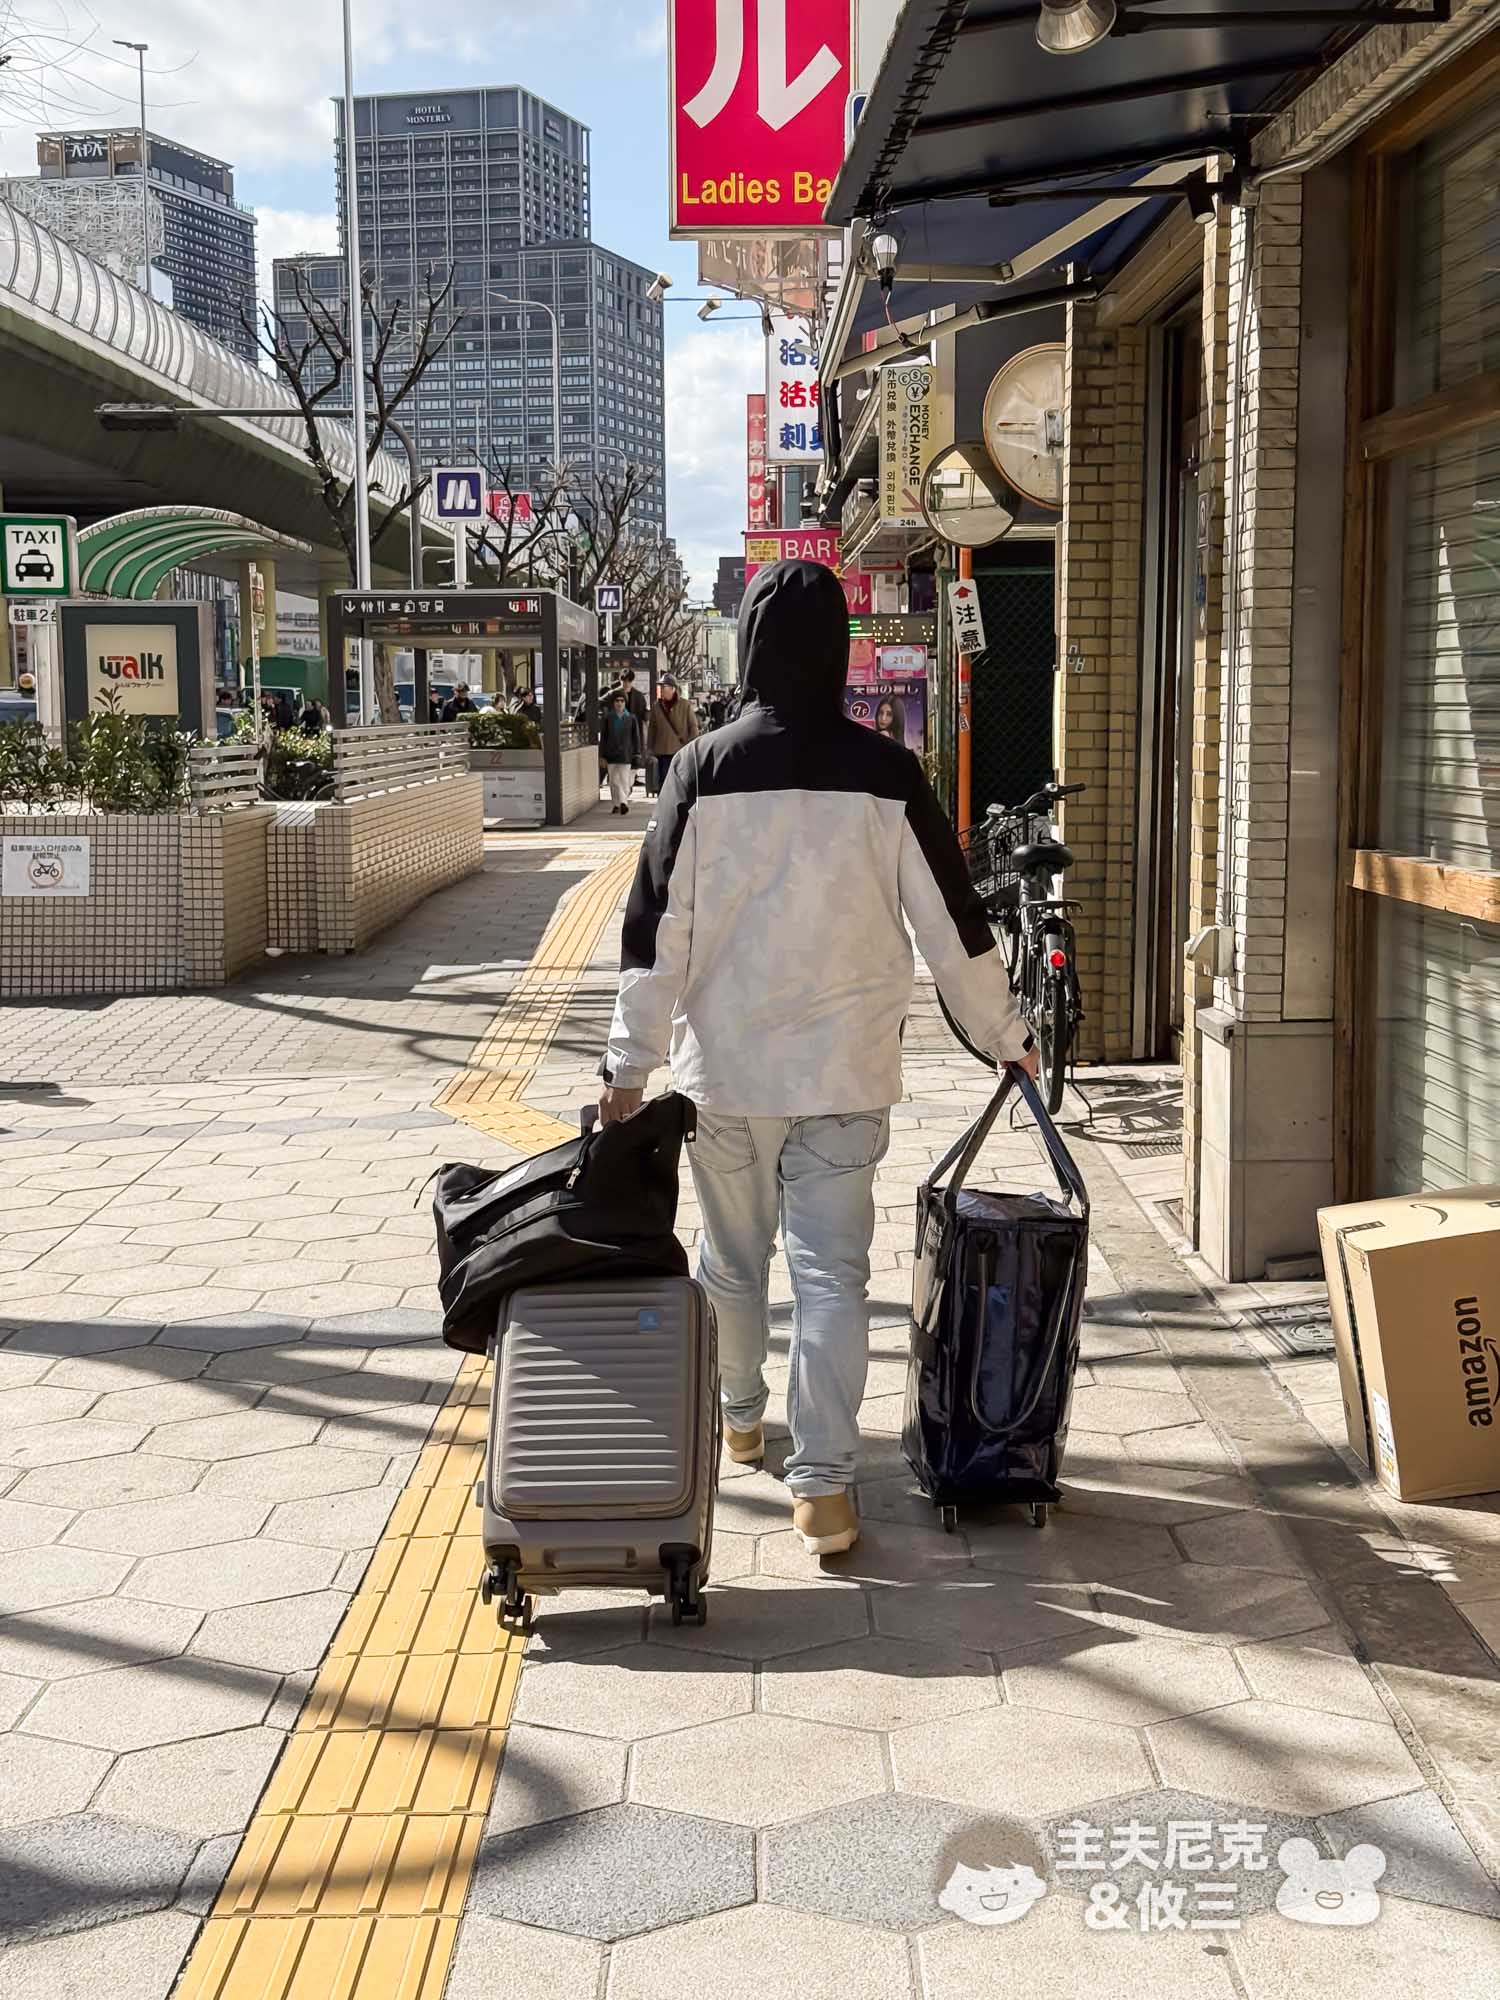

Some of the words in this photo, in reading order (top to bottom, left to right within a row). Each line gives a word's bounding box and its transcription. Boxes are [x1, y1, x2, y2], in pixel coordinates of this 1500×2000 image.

[682, 0, 843, 132] ル
[406, 114, 451, 125] MONTEREY
[415, 105, 442, 115] HOTEL
[72, 141, 103, 157] APA
[682, 173, 780, 204] Ladies
[793, 171, 833, 204] Ba
[779, 338, 820, 370] 活
[921, 404, 930, 440] MONEY
[909, 404, 921, 486] EXCHANGE
[11, 531, 56, 544] TAXI
[784, 538, 831, 560] BAR
[508, 600, 539, 614] walk
[451, 621, 481, 635] walk
[956, 604, 982, 649] 注意
[99, 653, 164, 680] walk
[853, 705, 868, 717] 7F
[1454, 1296, 1494, 1427] amazon
